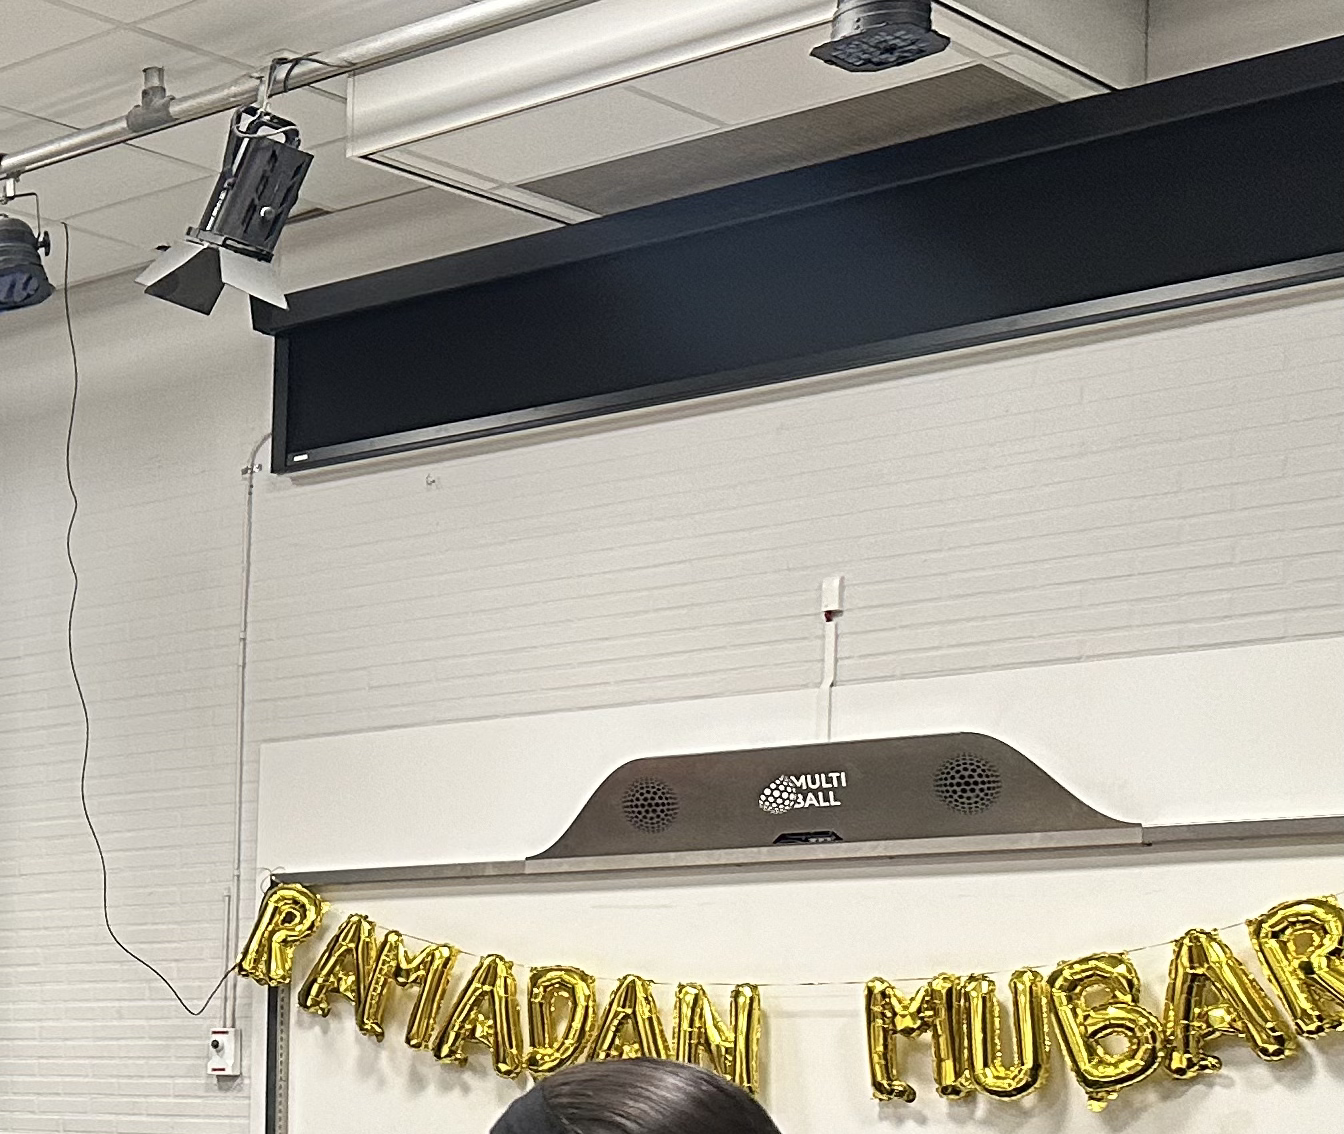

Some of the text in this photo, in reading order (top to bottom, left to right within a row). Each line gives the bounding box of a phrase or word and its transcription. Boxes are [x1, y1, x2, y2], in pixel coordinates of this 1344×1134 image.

[790, 772, 847, 790] MULTI
[793, 790, 841, 809] BALL
[236, 883, 1344, 1108] RAMADAN MUBAR
